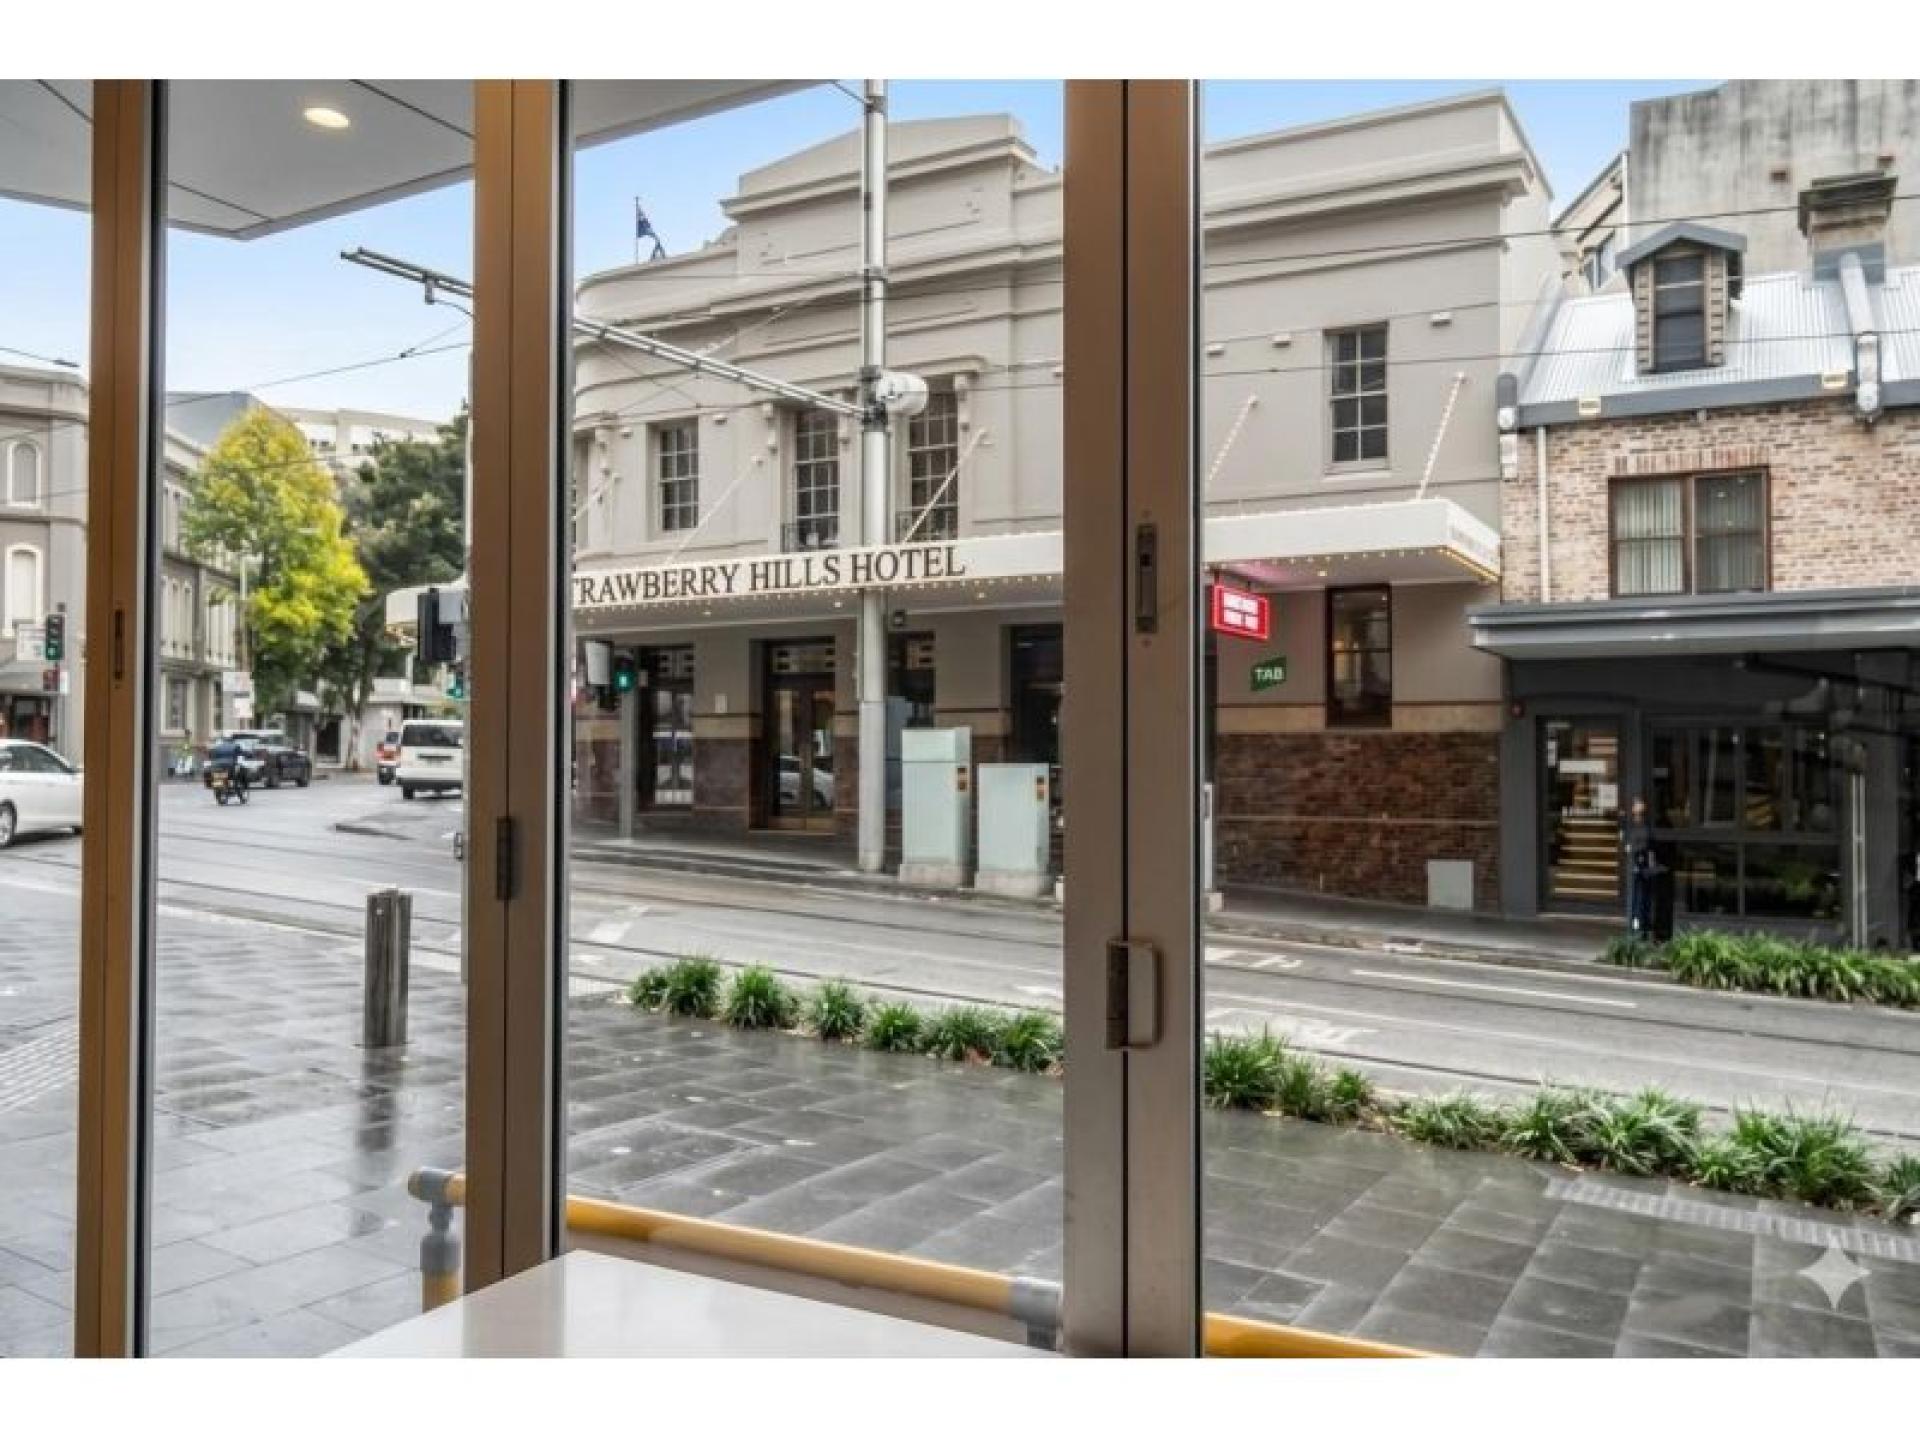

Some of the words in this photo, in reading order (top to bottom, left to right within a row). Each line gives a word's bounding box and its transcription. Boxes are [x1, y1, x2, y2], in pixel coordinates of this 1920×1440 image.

[749, 553, 841, 591] HILLS
[850, 546, 966, 584] HOTEL
[1254, 666, 1285, 682] TAB
